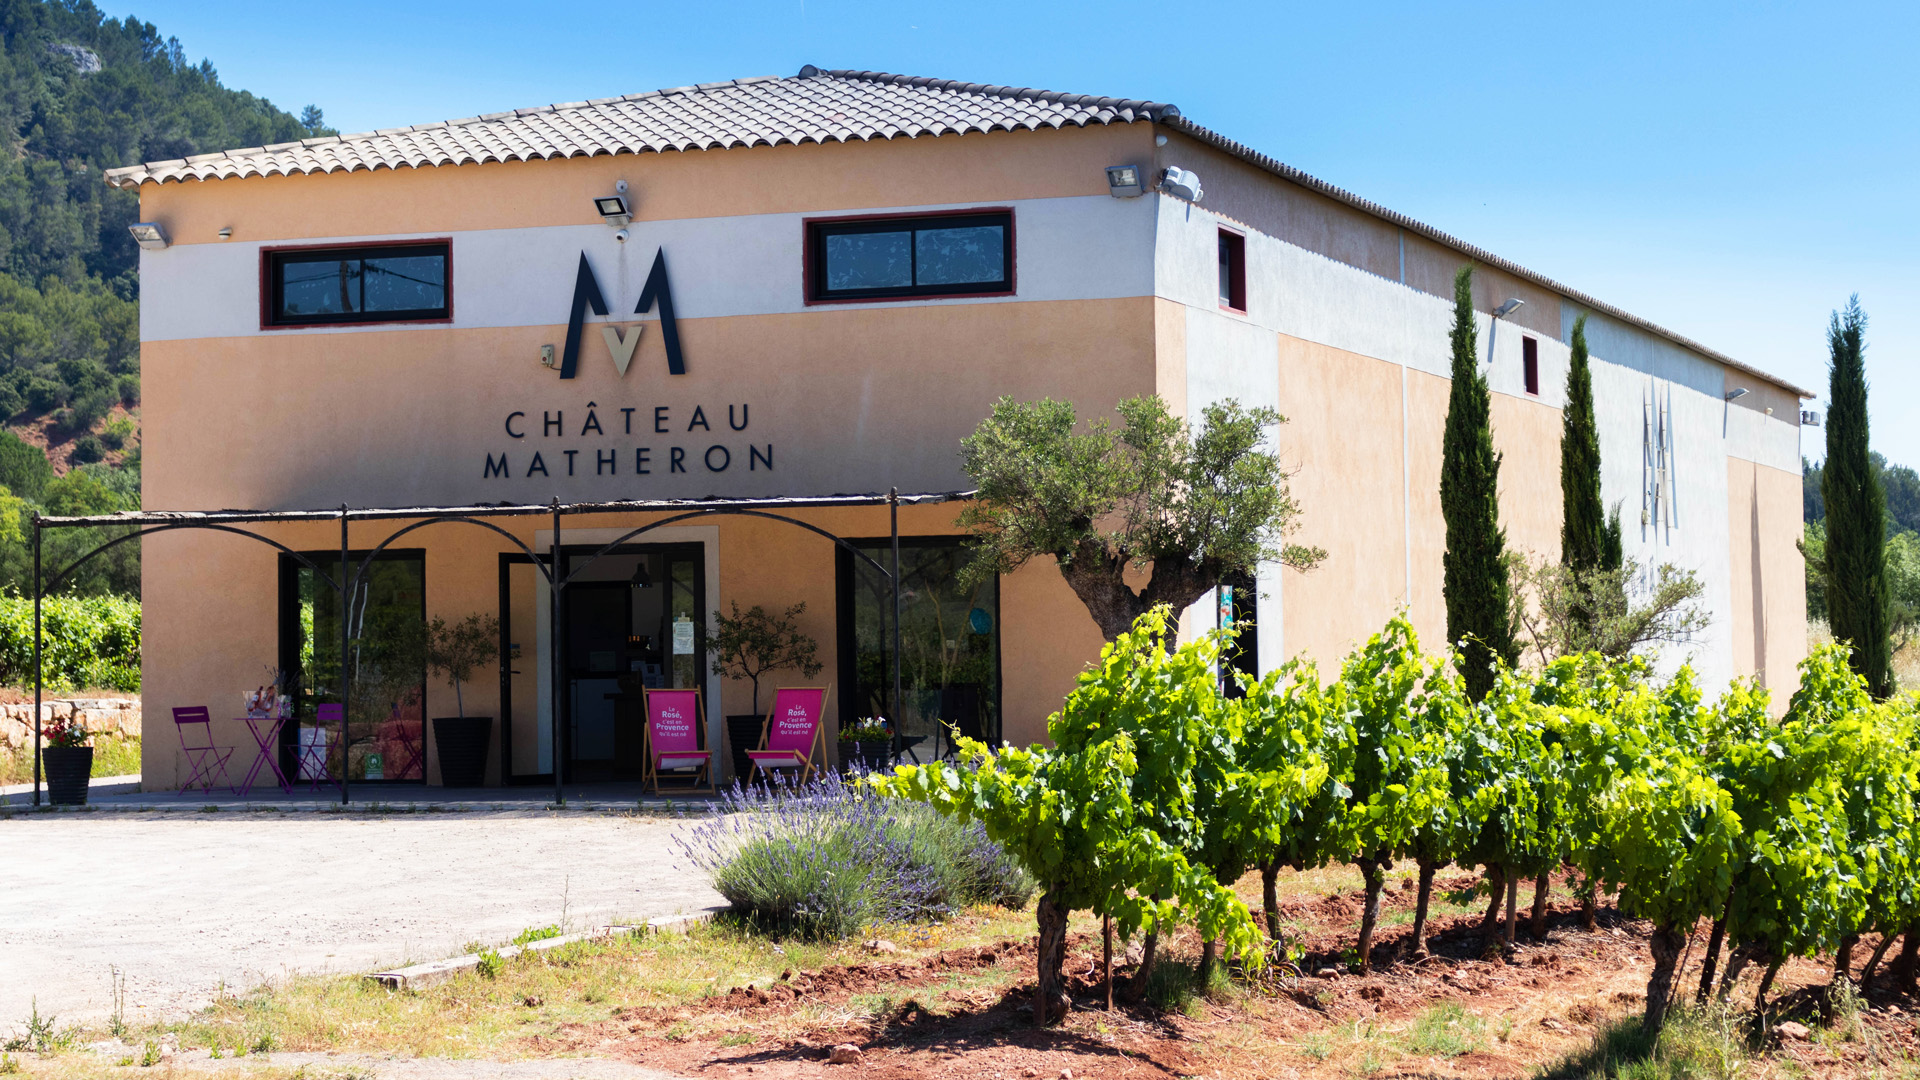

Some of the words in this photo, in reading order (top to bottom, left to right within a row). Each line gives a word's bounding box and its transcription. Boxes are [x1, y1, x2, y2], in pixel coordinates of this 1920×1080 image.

[505, 401, 748, 438] CHÂTEAU
[483, 443, 773, 478] MATHERON
[661, 711, 682, 719] Rosé,
[787, 708, 807, 717] Rosé,
[656, 723, 689, 731] Provence
[779, 721, 812, 729] Provence
